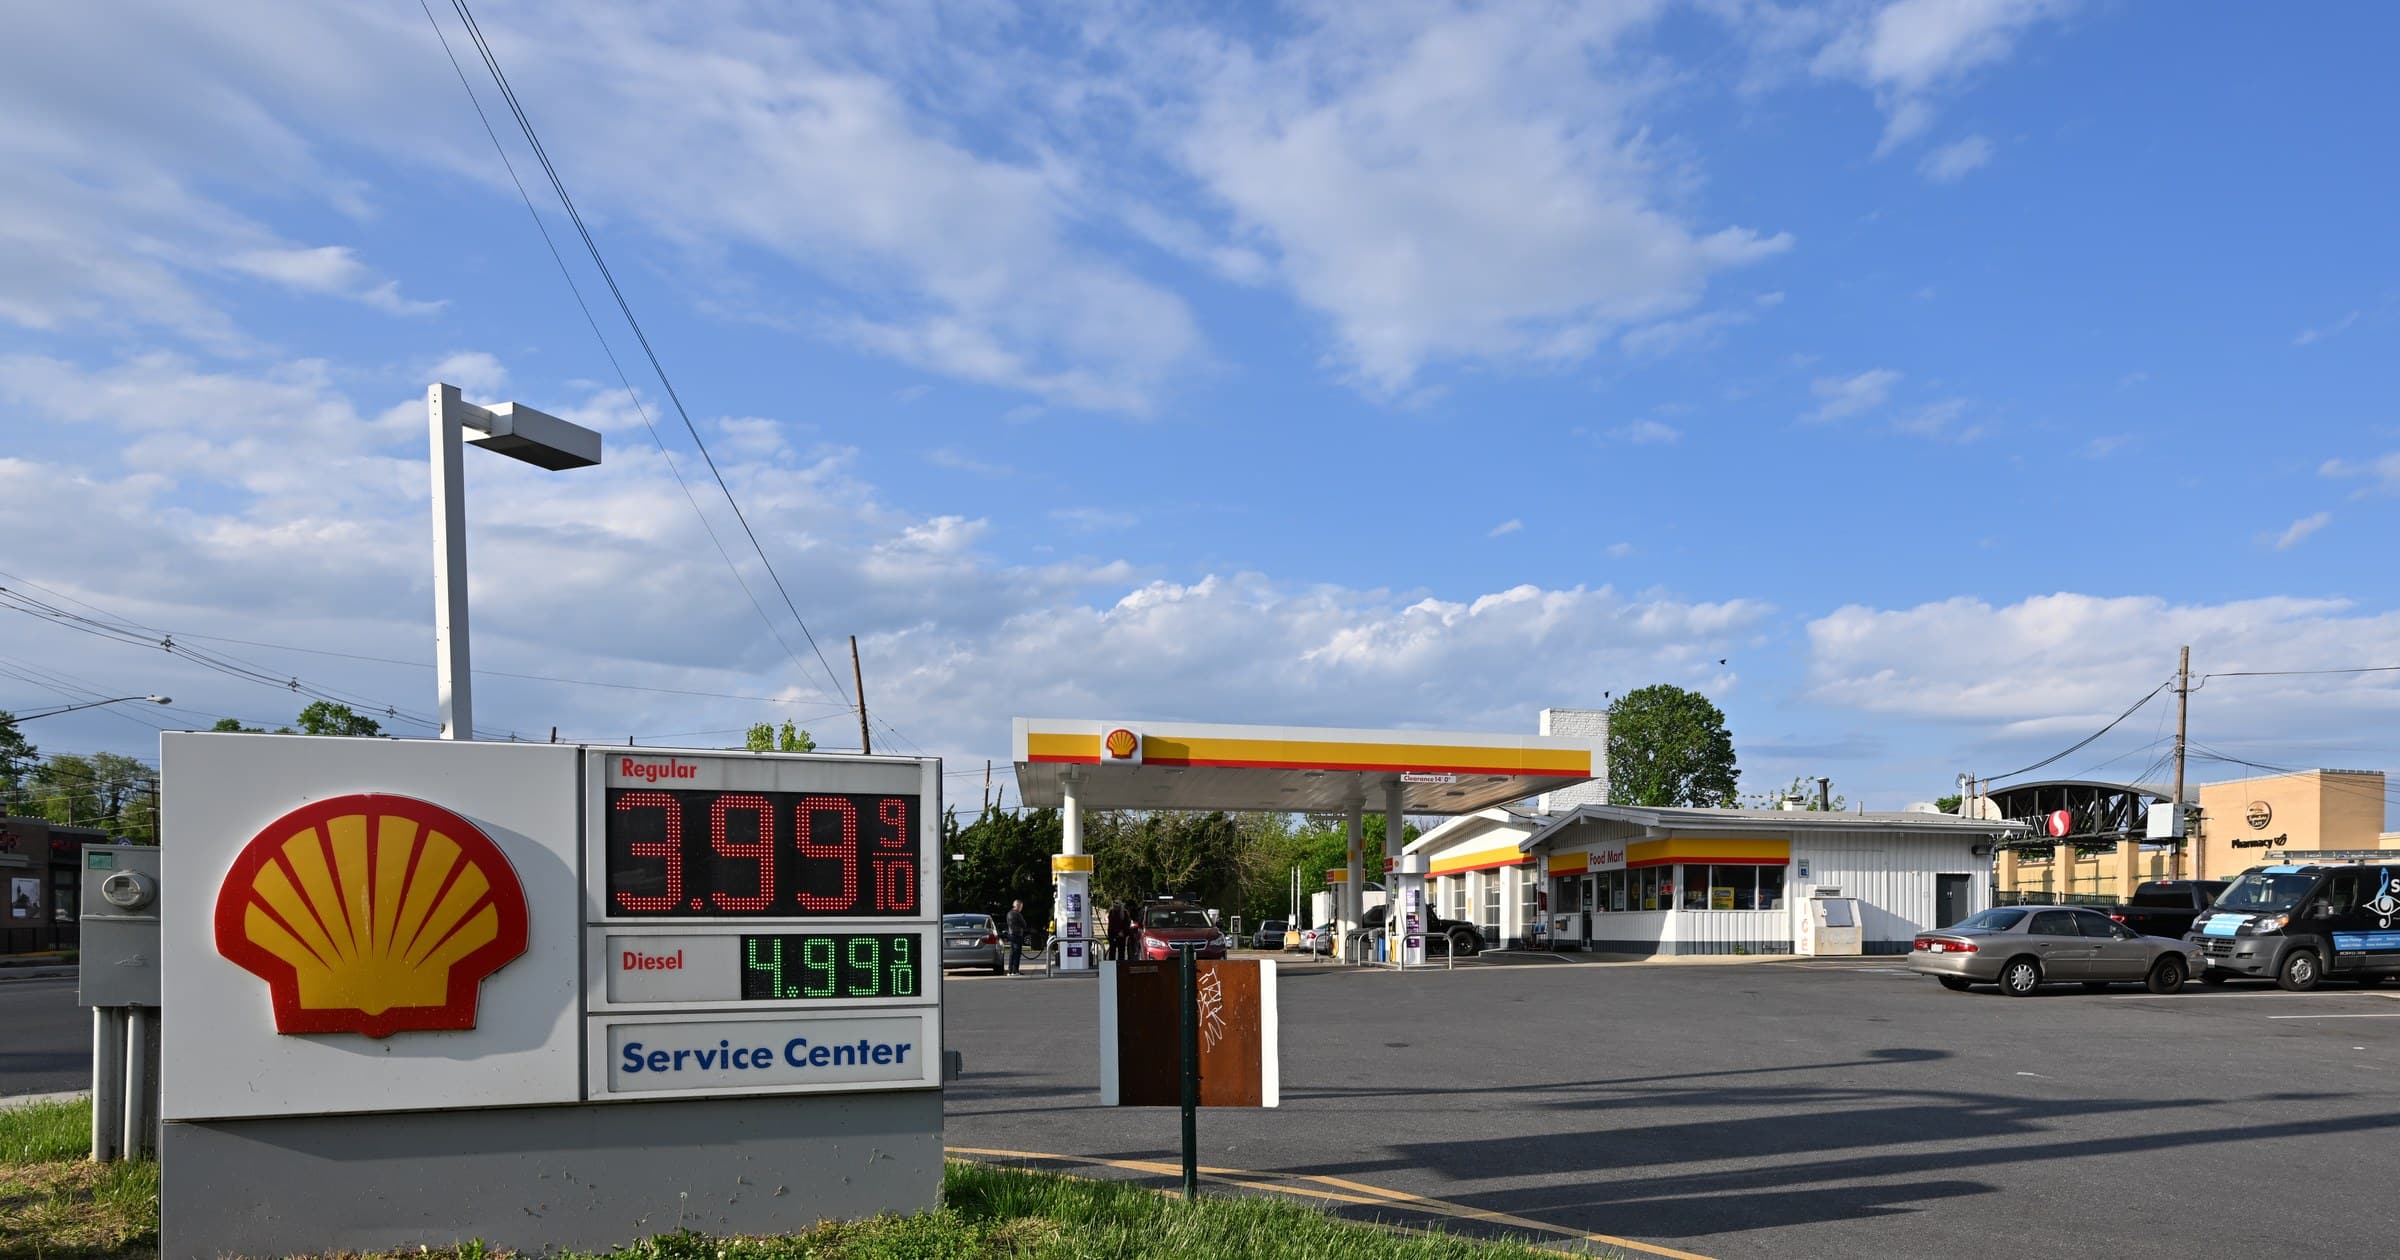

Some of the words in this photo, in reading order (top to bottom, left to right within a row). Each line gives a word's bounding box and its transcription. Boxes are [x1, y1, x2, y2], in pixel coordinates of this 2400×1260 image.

[621, 757, 697, 782] Regular
[616, 792, 857, 911] 3.99
[2231, 838, 2273, 849] Pharmacy
[1589, 850, 1605, 865] Food
[1607, 849, 1624, 863] Mart
[622, 949, 683, 971] Diesel
[748, 937, 880, 998] 4.99
[621, 1039, 773, 1074] Service
[784, 1038, 911, 1069] Center
